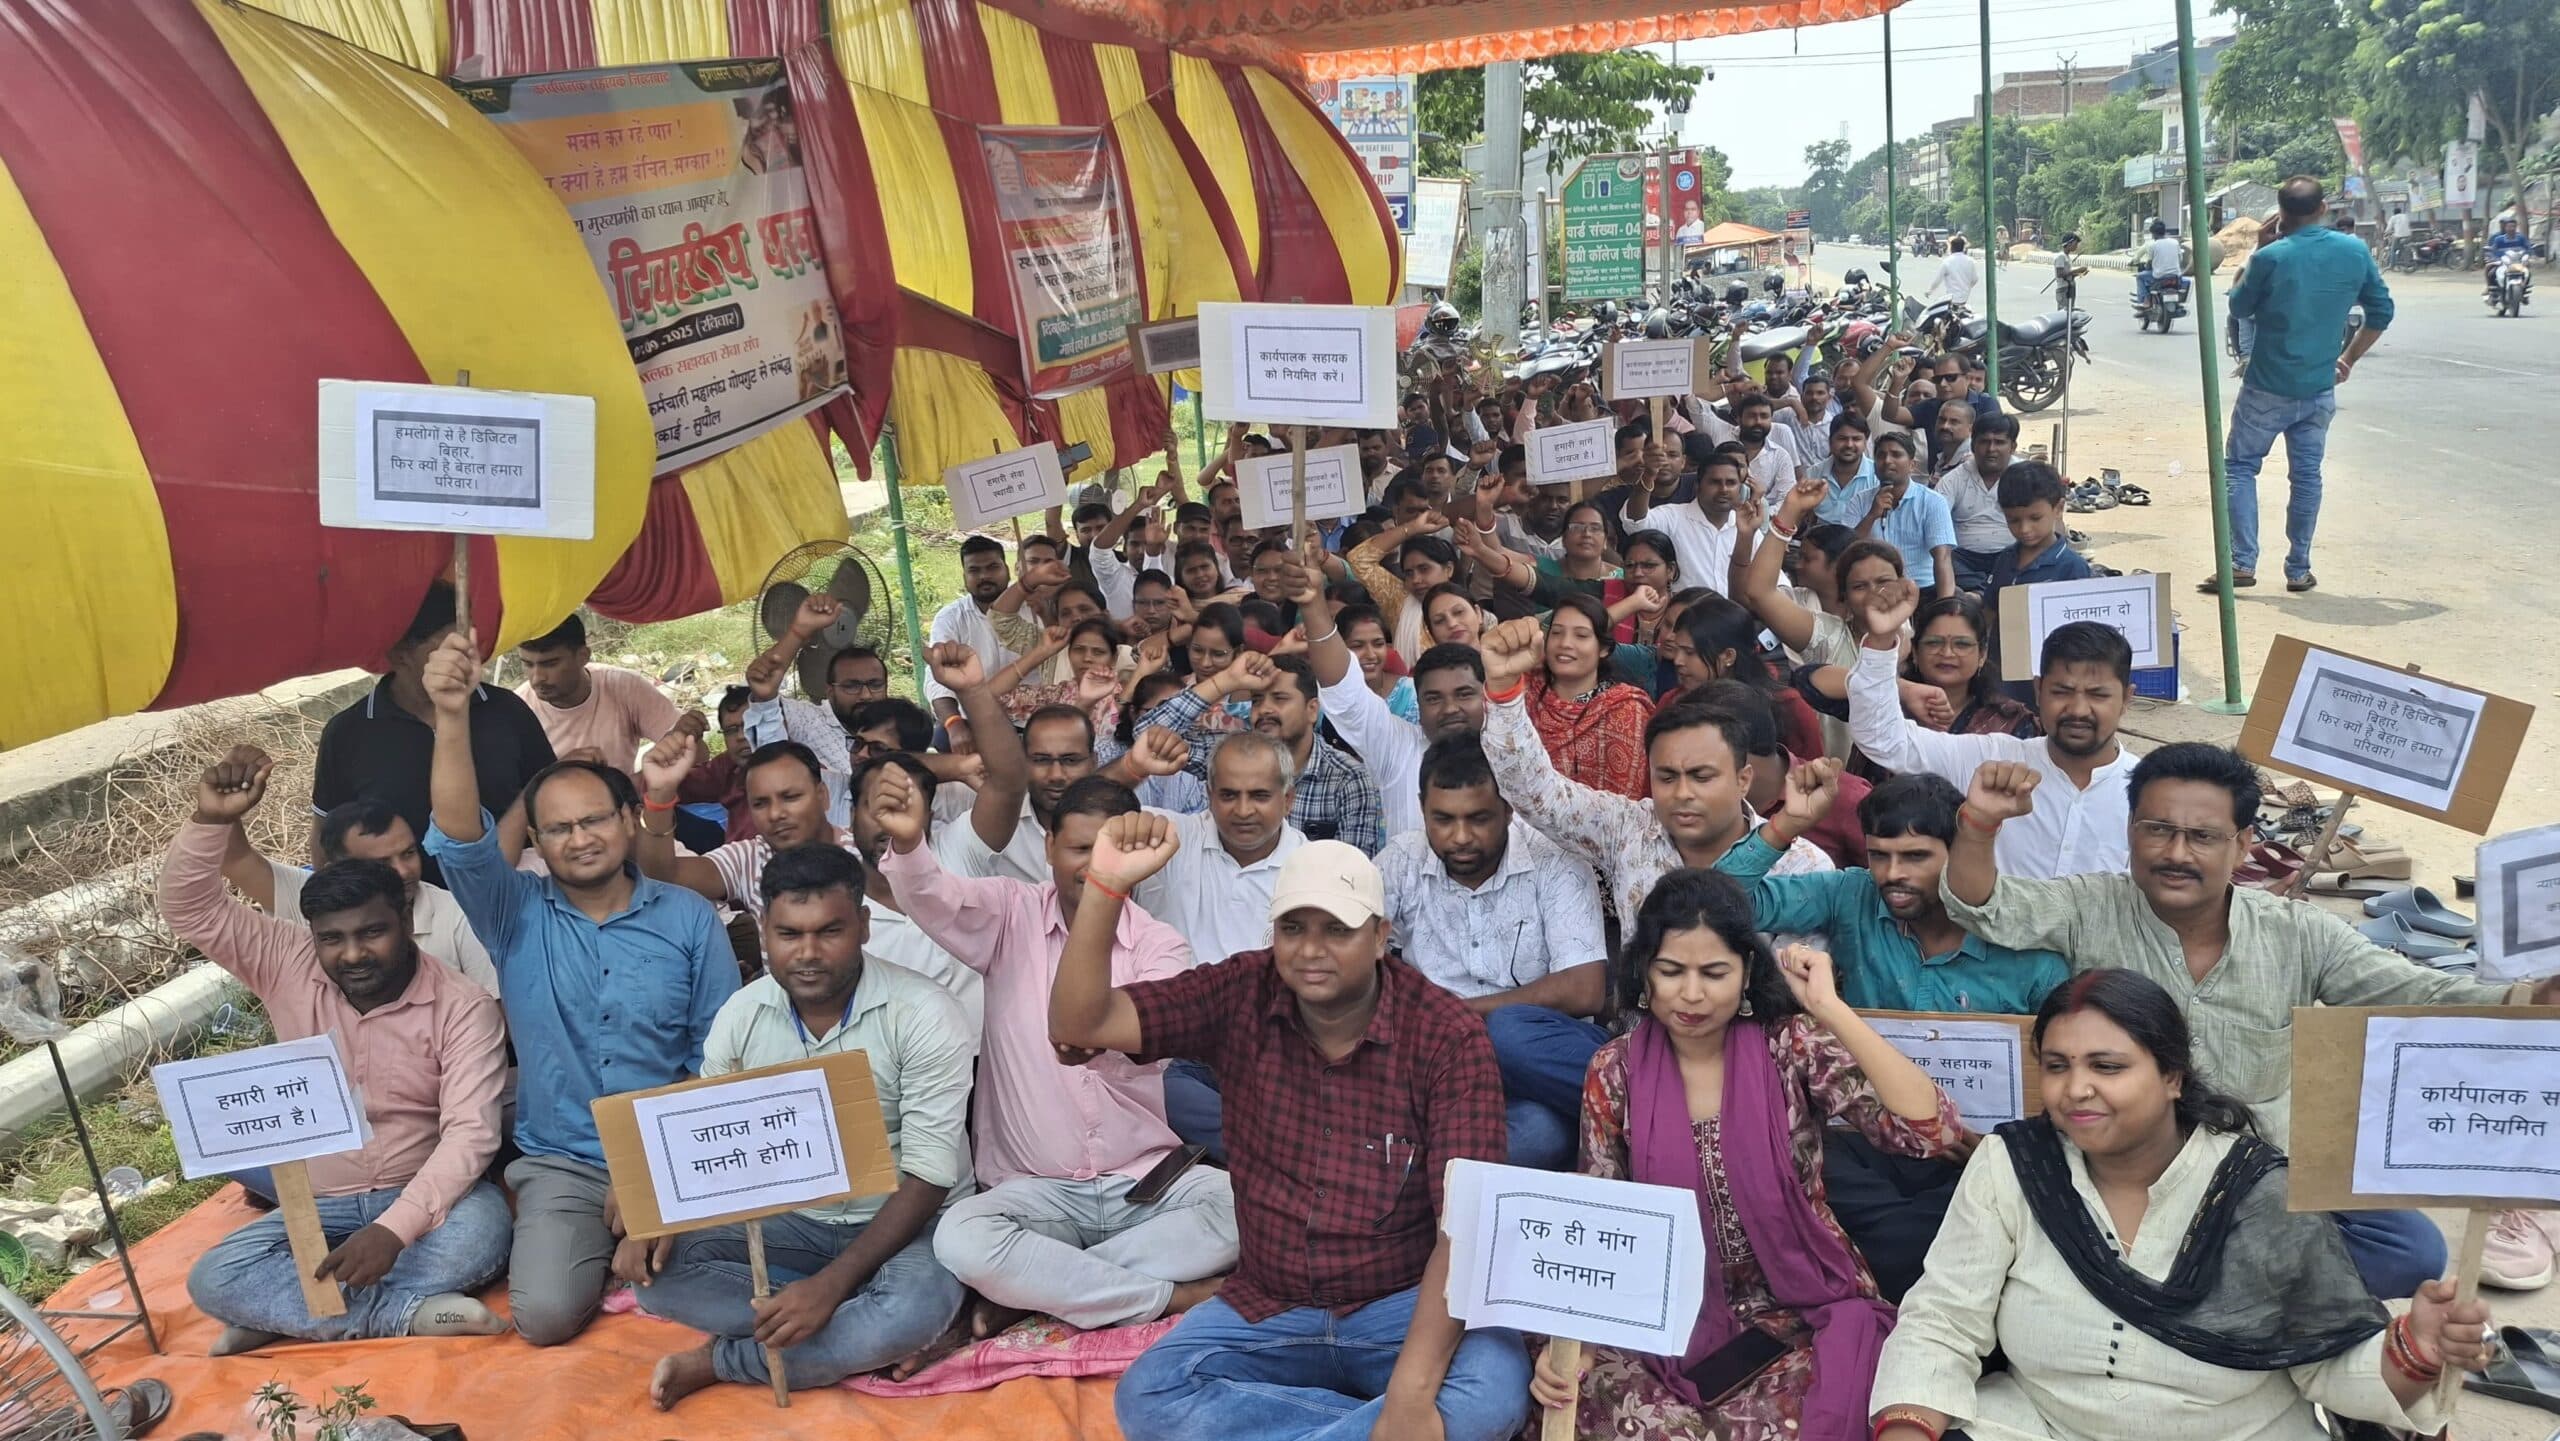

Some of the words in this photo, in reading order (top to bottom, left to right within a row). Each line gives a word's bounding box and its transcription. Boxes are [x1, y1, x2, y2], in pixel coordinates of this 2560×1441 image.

[608, 166, 628, 185] हम
[641, 206, 656, 221] का
[658, 202, 682, 216] ध्यान
[1566, 221, 1586, 238] वार्ड
[1589, 222, 1618, 237] संख्या
[1625, 223, 1641, 237] 04
[1565, 244, 1586, 264] डिग्री
[1589, 243, 1619, 262] कॉलेज
[608, 222, 756, 327] दिवसीय
[695, 311, 740, 338] (रविवार)
[677, 350, 719, 374] सहायता
[720, 344, 741, 362] सेवा
[1259, 348, 1307, 363] कार्यपालक
[1312, 353, 1348, 364] सहायक
[690, 376, 727, 402] महासंघ
[759, 360, 769, 379] से
[1264, 368, 1278, 381] को
[1282, 369, 1317, 382] नियमित
[395, 426, 440, 441] हमलोगों
[444, 429, 453, 441] से
[458, 428, 466, 442] है
[471, 430, 518, 445] डिजिटल
[655, 418, 682, 446] काई
[693, 405, 721, 437] सुपौल
[1554, 440, 1575, 451] हमारी
[391, 457, 413, 471] फिर
[418, 457, 438, 471] क्यों
[442, 457, 450, 473] है
[455, 458, 485, 475] बेहाल
[490, 463, 522, 477] हमारा
[986, 474, 1007, 487] हमारी
[1010, 470, 1025, 480] सेवा
[1018, 482, 1026, 493] हो
[2063, 605, 2111, 620] वेतनमान
[2117, 600, 2131, 615] दो
[2331, 687, 2374, 707] हमलोगों
[2377, 698, 2387, 711] से
[2390, 701, 2399, 715] है
[2402, 704, 2448, 728] डिजिटल
[2317, 711, 2340, 728] फिर
[2343, 719, 2363, 734] क्यों
[2365, 725, 2374, 738] है
[2377, 728, 2408, 747] बेहाल
[2411, 740, 2443, 758] हमारा
[1939, 1057, 1992, 1070] सहायक
[216, 1085, 265, 1111] हमारी
[274, 1077, 309, 1099] मांगें
[2420, 1081, 2529, 1105] कार्यपालक
[225, 1114, 281, 1137] जायज
[690, 1119, 750, 1145] जायज
[760, 1106, 798, 1131] मांगें
[2428, 1113, 2456, 1133] को
[2468, 1113, 2548, 1137] नियमित
[691, 1149, 748, 1175] माननी
[1520, 1218, 1552, 1240] एक
[1564, 1219, 1586, 1246] ही
[1597, 1228, 1637, 1254] मांग
[1532, 1252, 1616, 1290] वेतनमान
